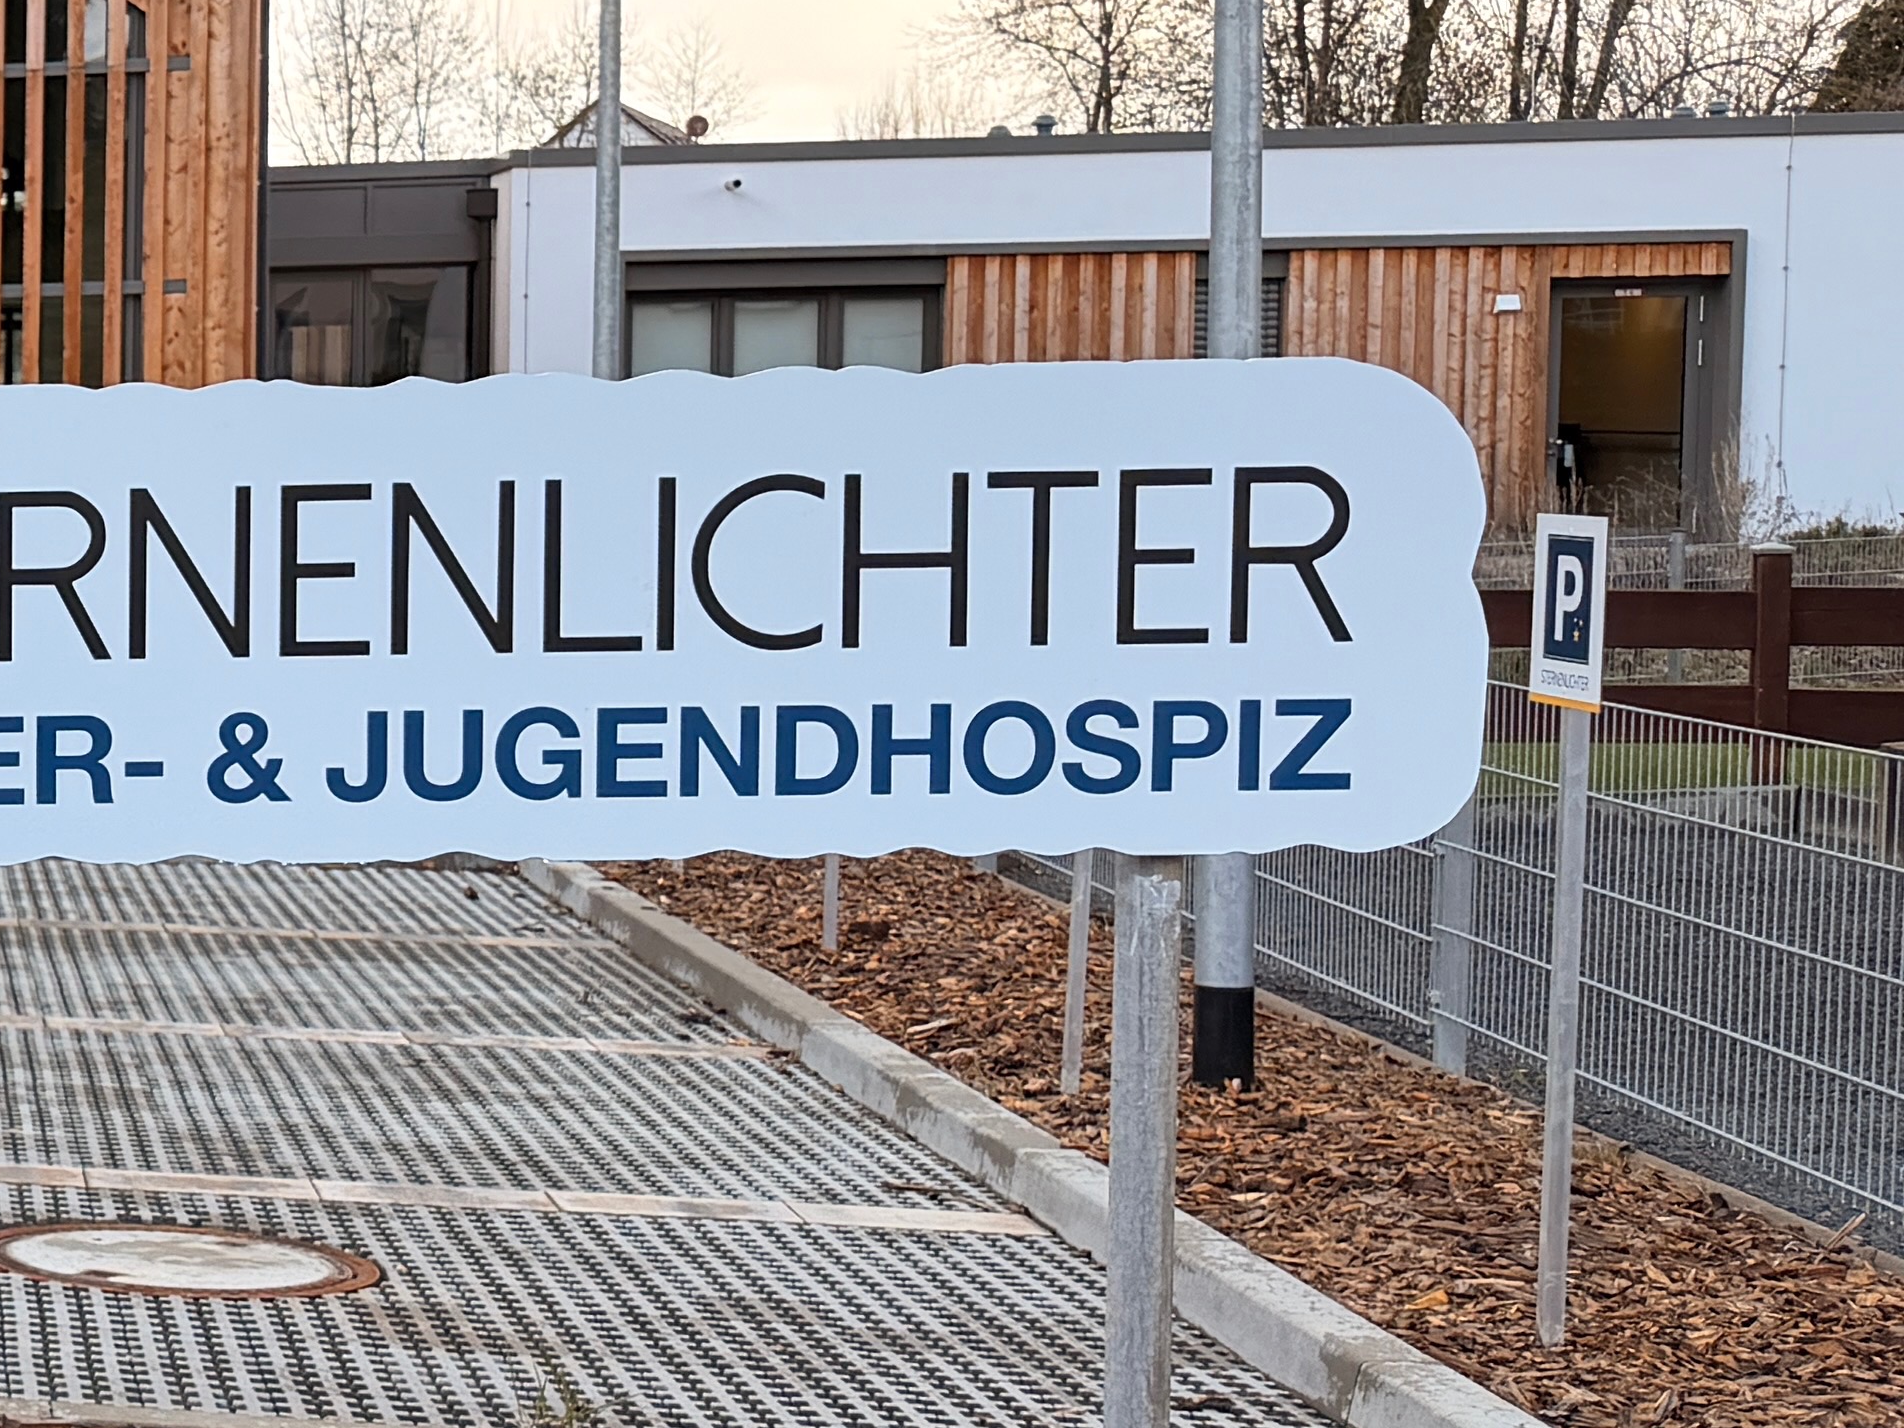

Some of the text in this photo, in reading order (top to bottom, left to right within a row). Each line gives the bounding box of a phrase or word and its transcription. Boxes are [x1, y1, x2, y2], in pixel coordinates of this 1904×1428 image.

[1554, 555, 1584, 642] P
[207, 712, 292, 803] &
[326, 699, 1351, 802] JUGENDHOSPIZ
